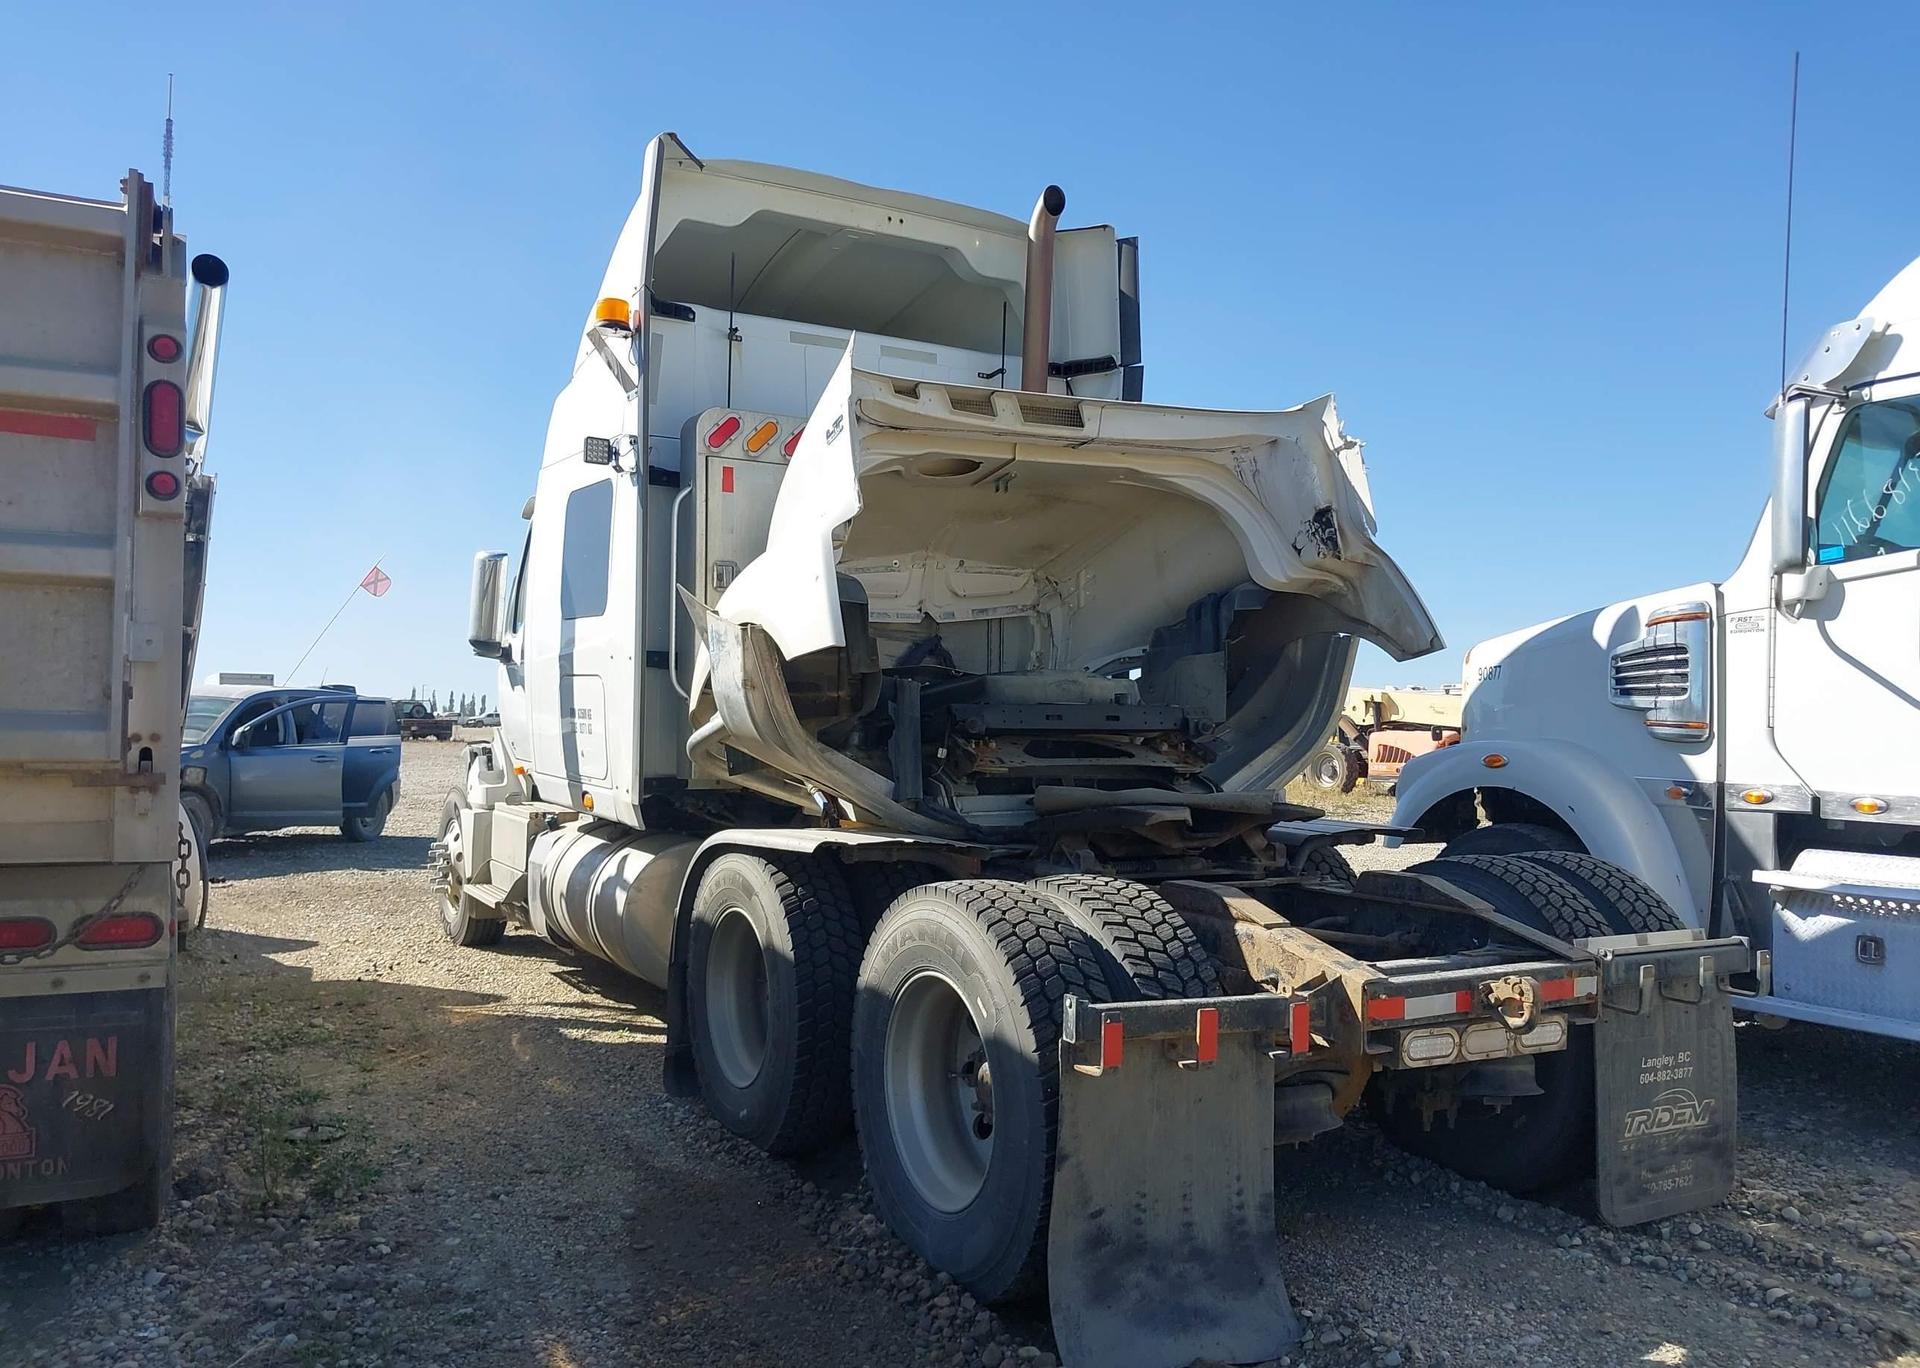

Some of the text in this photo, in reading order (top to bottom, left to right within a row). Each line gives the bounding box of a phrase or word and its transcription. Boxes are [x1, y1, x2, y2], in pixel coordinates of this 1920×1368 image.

[1478, 665, 1501, 681] 90877
[8, 1036, 118, 1083] JAN
[1642, 1051, 1691, 1069] Langley, BC
[1640, 1067, 1693, 1084] 604-882-3877
[1625, 1099, 1715, 1137] TRIDEM
